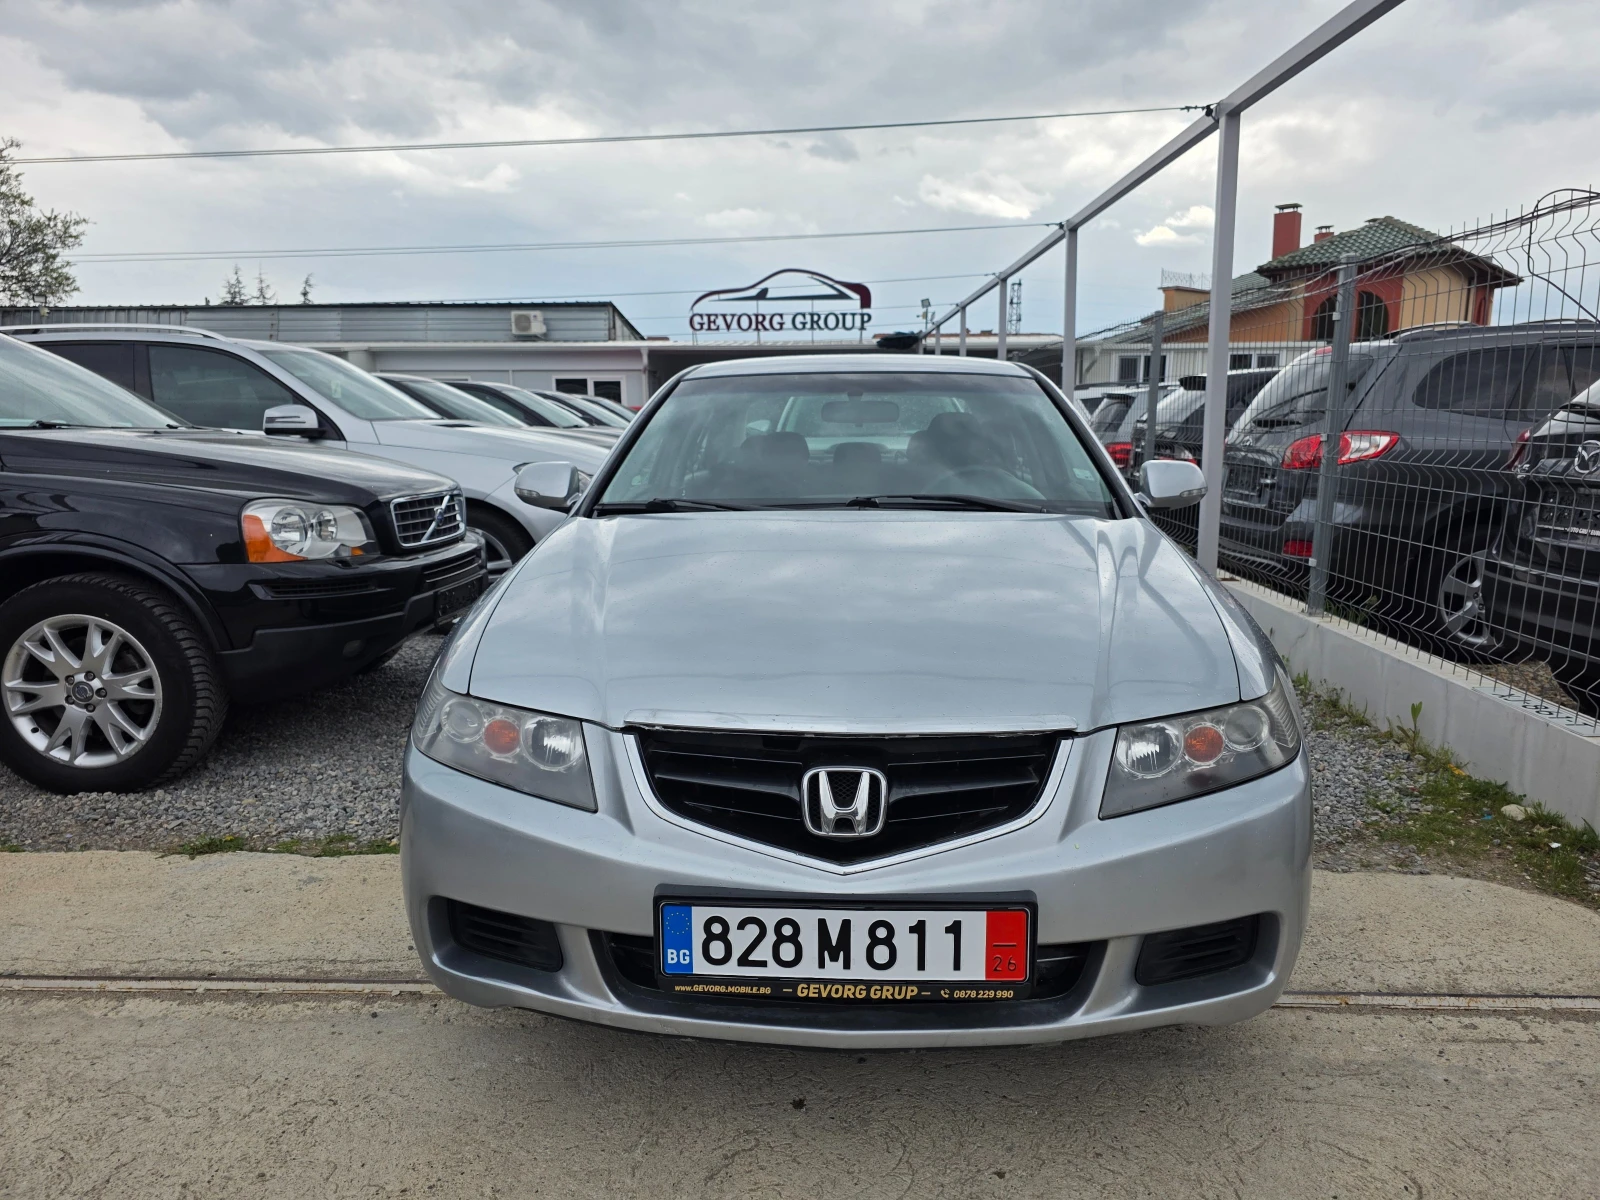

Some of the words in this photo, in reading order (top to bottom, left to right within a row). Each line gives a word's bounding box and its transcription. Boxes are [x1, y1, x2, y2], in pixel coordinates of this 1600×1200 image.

[689, 312, 785, 332] GEVORG
[791, 312, 872, 332] GROUP
[701, 915, 803, 968] 828
[817, 918, 851, 970] M
[865, 919, 963, 971] 811
[666, 949, 690, 965] BG
[993, 954, 1017, 972] 26
[674, 984, 771, 995] www.GEVORG.MOBILE.BG
[796, 983, 867, 999] GEVORG
[870, 985, 918, 1000] GRUP
[953, 990, 977, 999] 0878
[977, 990, 995, 999] 229
[995, 990, 1014, 999] 990
